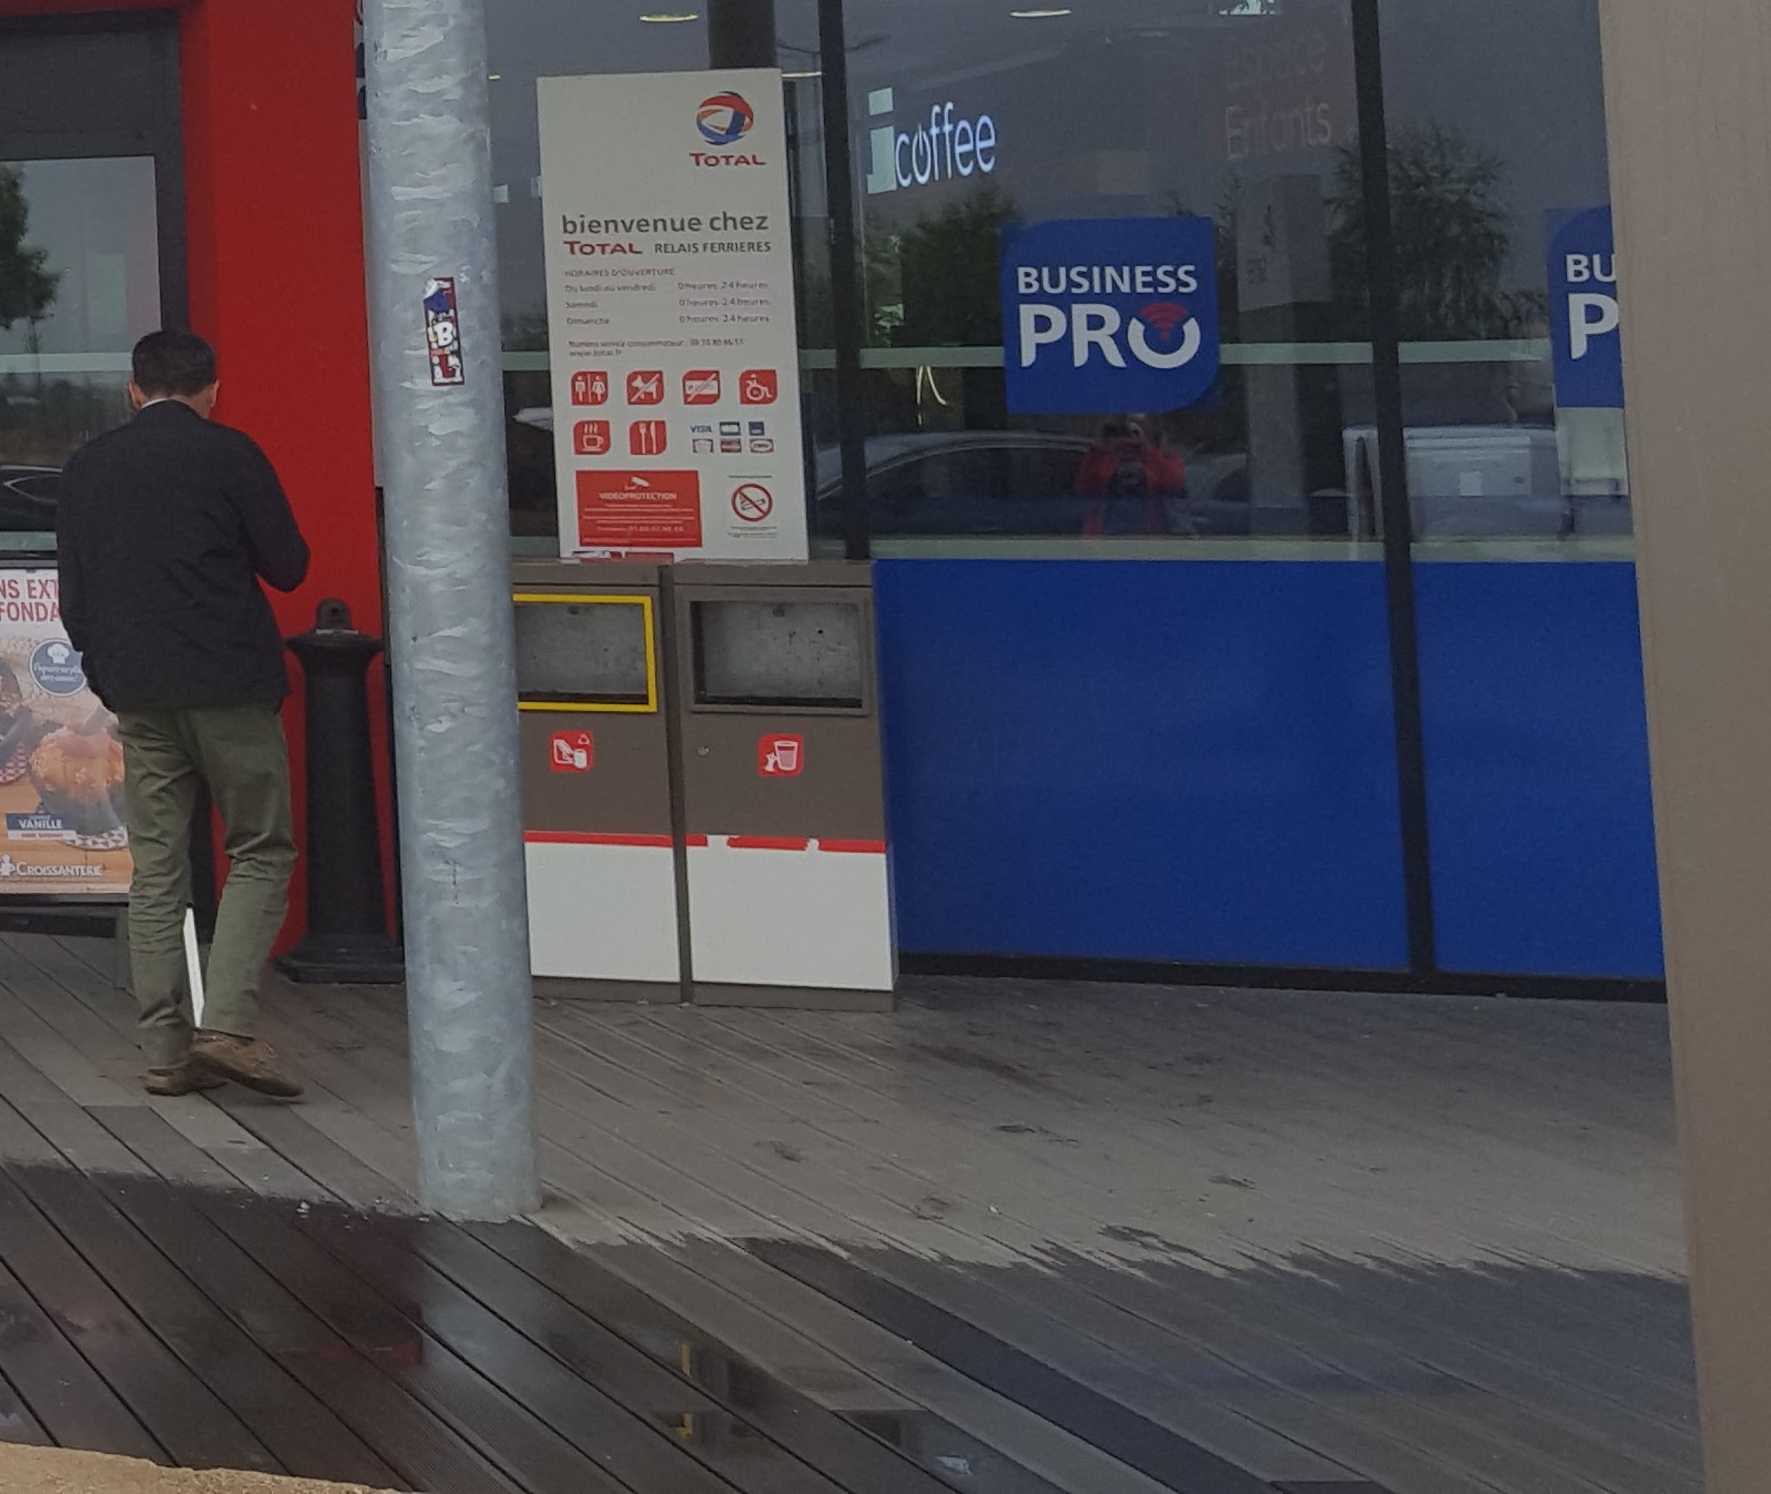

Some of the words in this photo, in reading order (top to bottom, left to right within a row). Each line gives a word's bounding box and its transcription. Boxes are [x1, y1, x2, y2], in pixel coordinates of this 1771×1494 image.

[689, 152, 767, 167] TOTAL
[561, 214, 702, 235] bienvenue
[709, 210, 769, 231] chez
[563, 240, 643, 256] TOTAL
[655, 242, 699, 254] RELAIS
[702, 241, 771, 253] FERRIERES
[1566, 253, 1616, 283] BU
[1017, 265, 1198, 294] BUSINESS
[1019, 302, 1201, 369] PRO
[19, 819, 62, 829] VANILLE
[16, 861, 102, 876] CROISSANTERIE
